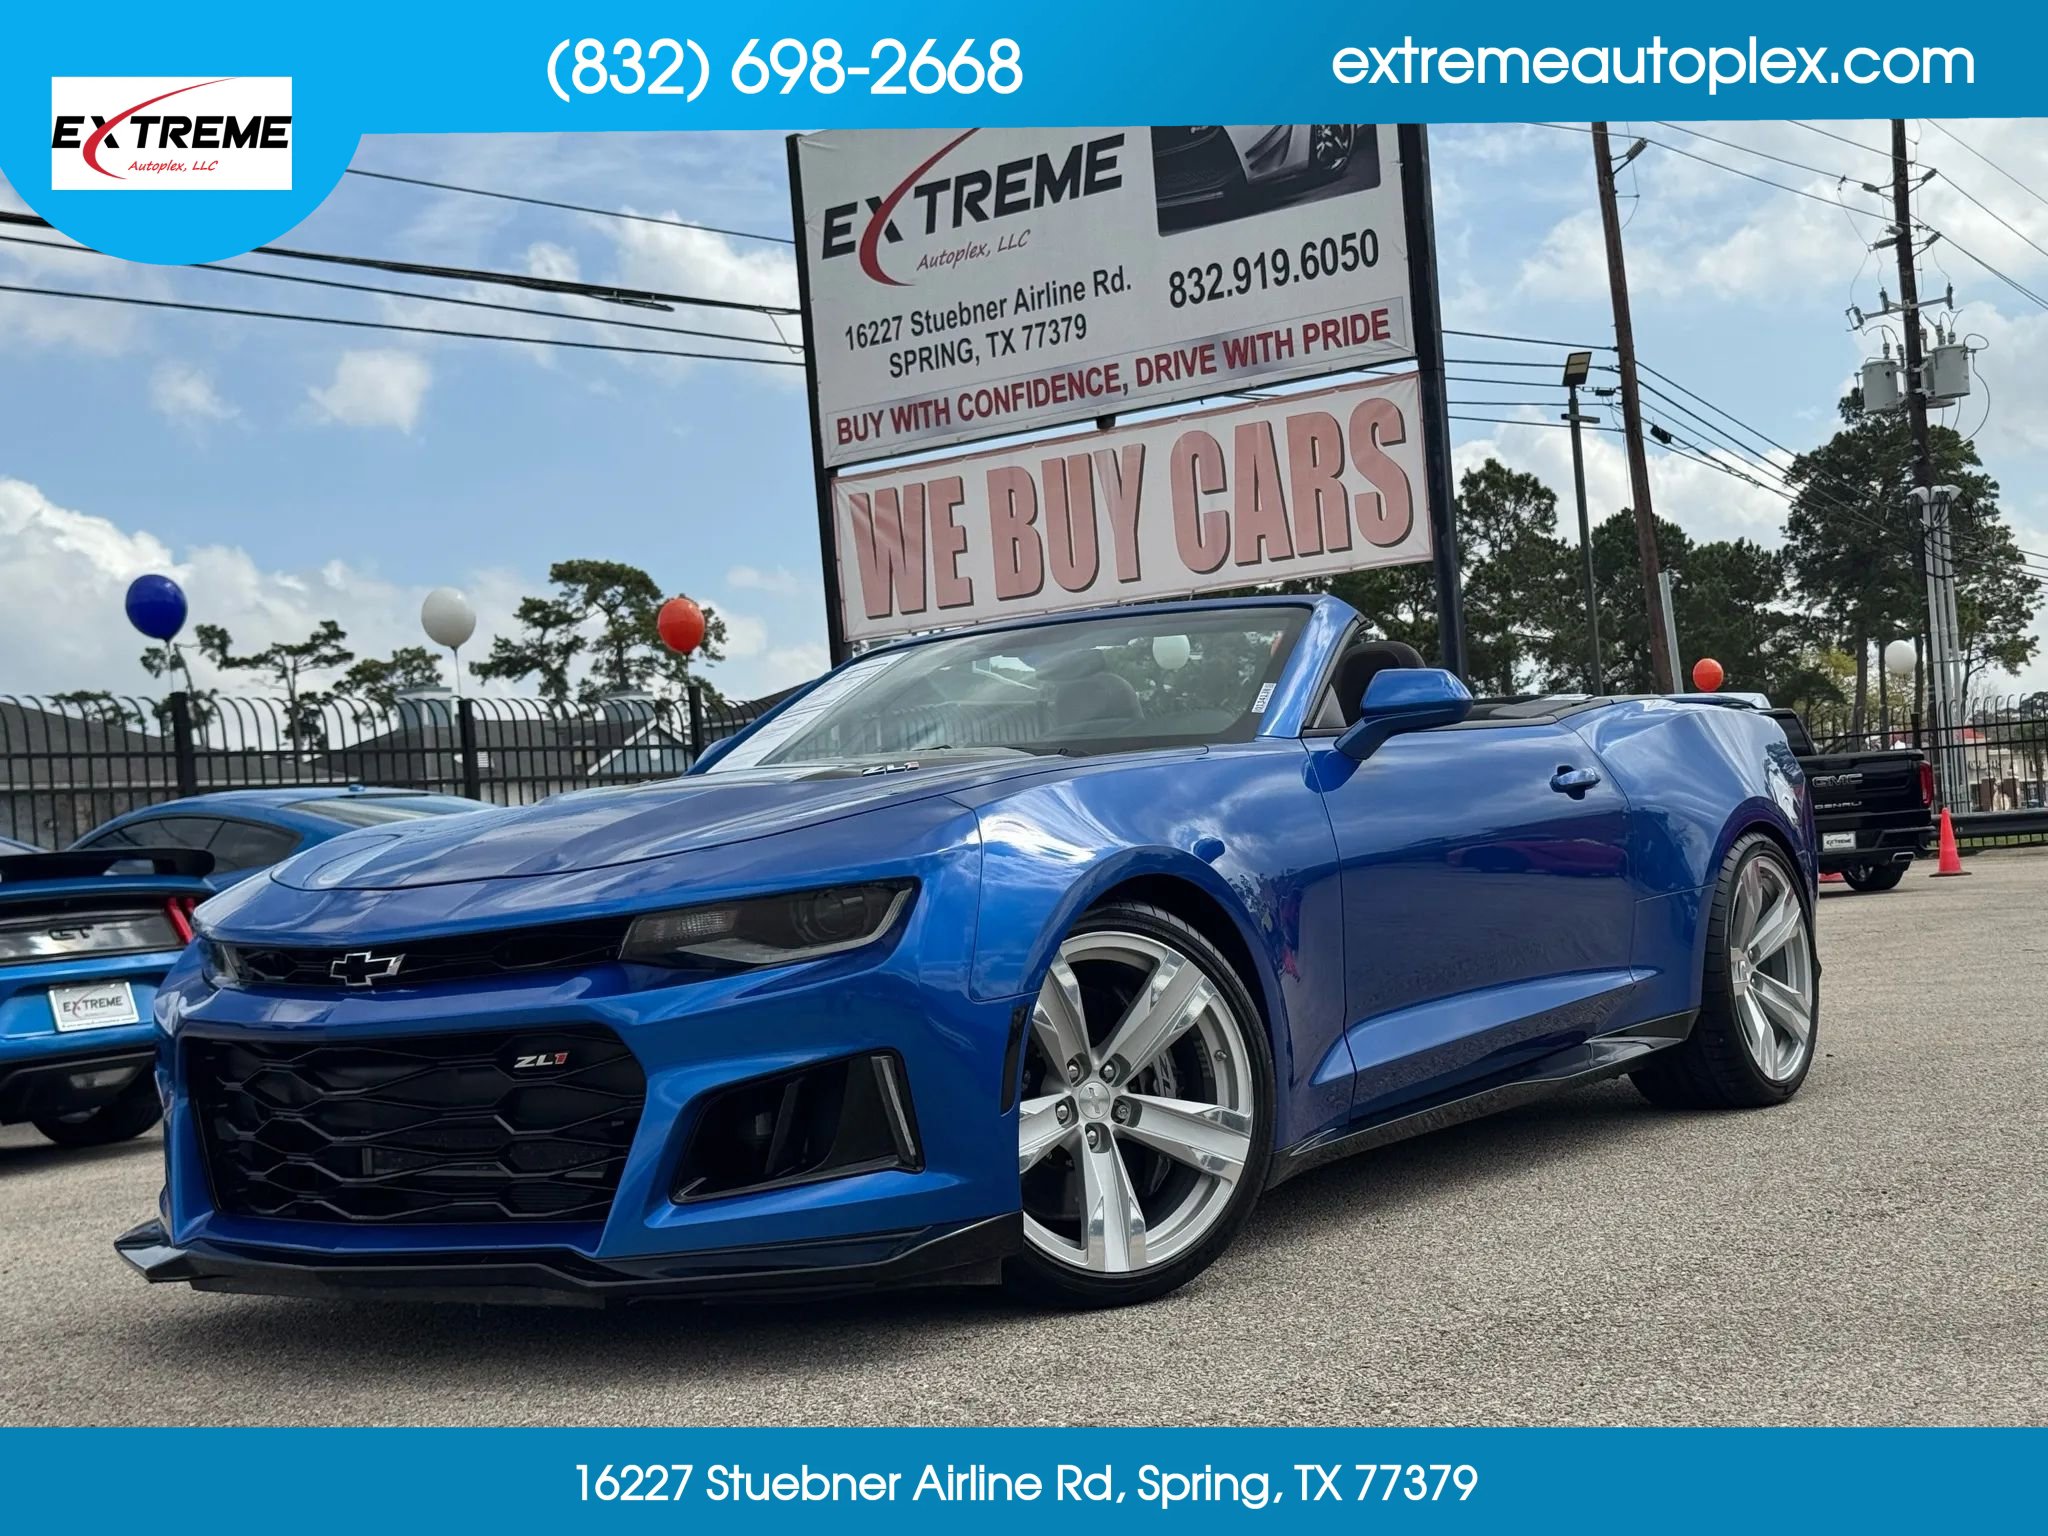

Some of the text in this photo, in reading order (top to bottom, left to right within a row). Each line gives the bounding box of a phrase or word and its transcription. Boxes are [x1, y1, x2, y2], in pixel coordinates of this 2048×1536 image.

[821, 132, 1126, 260] EXTREME
[916, 229, 1032, 271] Autoplex, LLC
[1169, 228, 1380, 309] 832.919.6050
[845, 265, 1132, 352] 16227 Stuebner Airline Rd.
[836, 308, 1391, 446] BUY WITH CONFIDENCE, DRIVE WITH PRIDE
[889, 313, 1088, 379] SPRING, TX 77379
[848, 397, 1414, 619] WE BUY CARS
[1812, 773, 1863, 788] GMC
[63, 996, 123, 1013] EXTREME
[513, 1053, 569, 1069] ZL1
